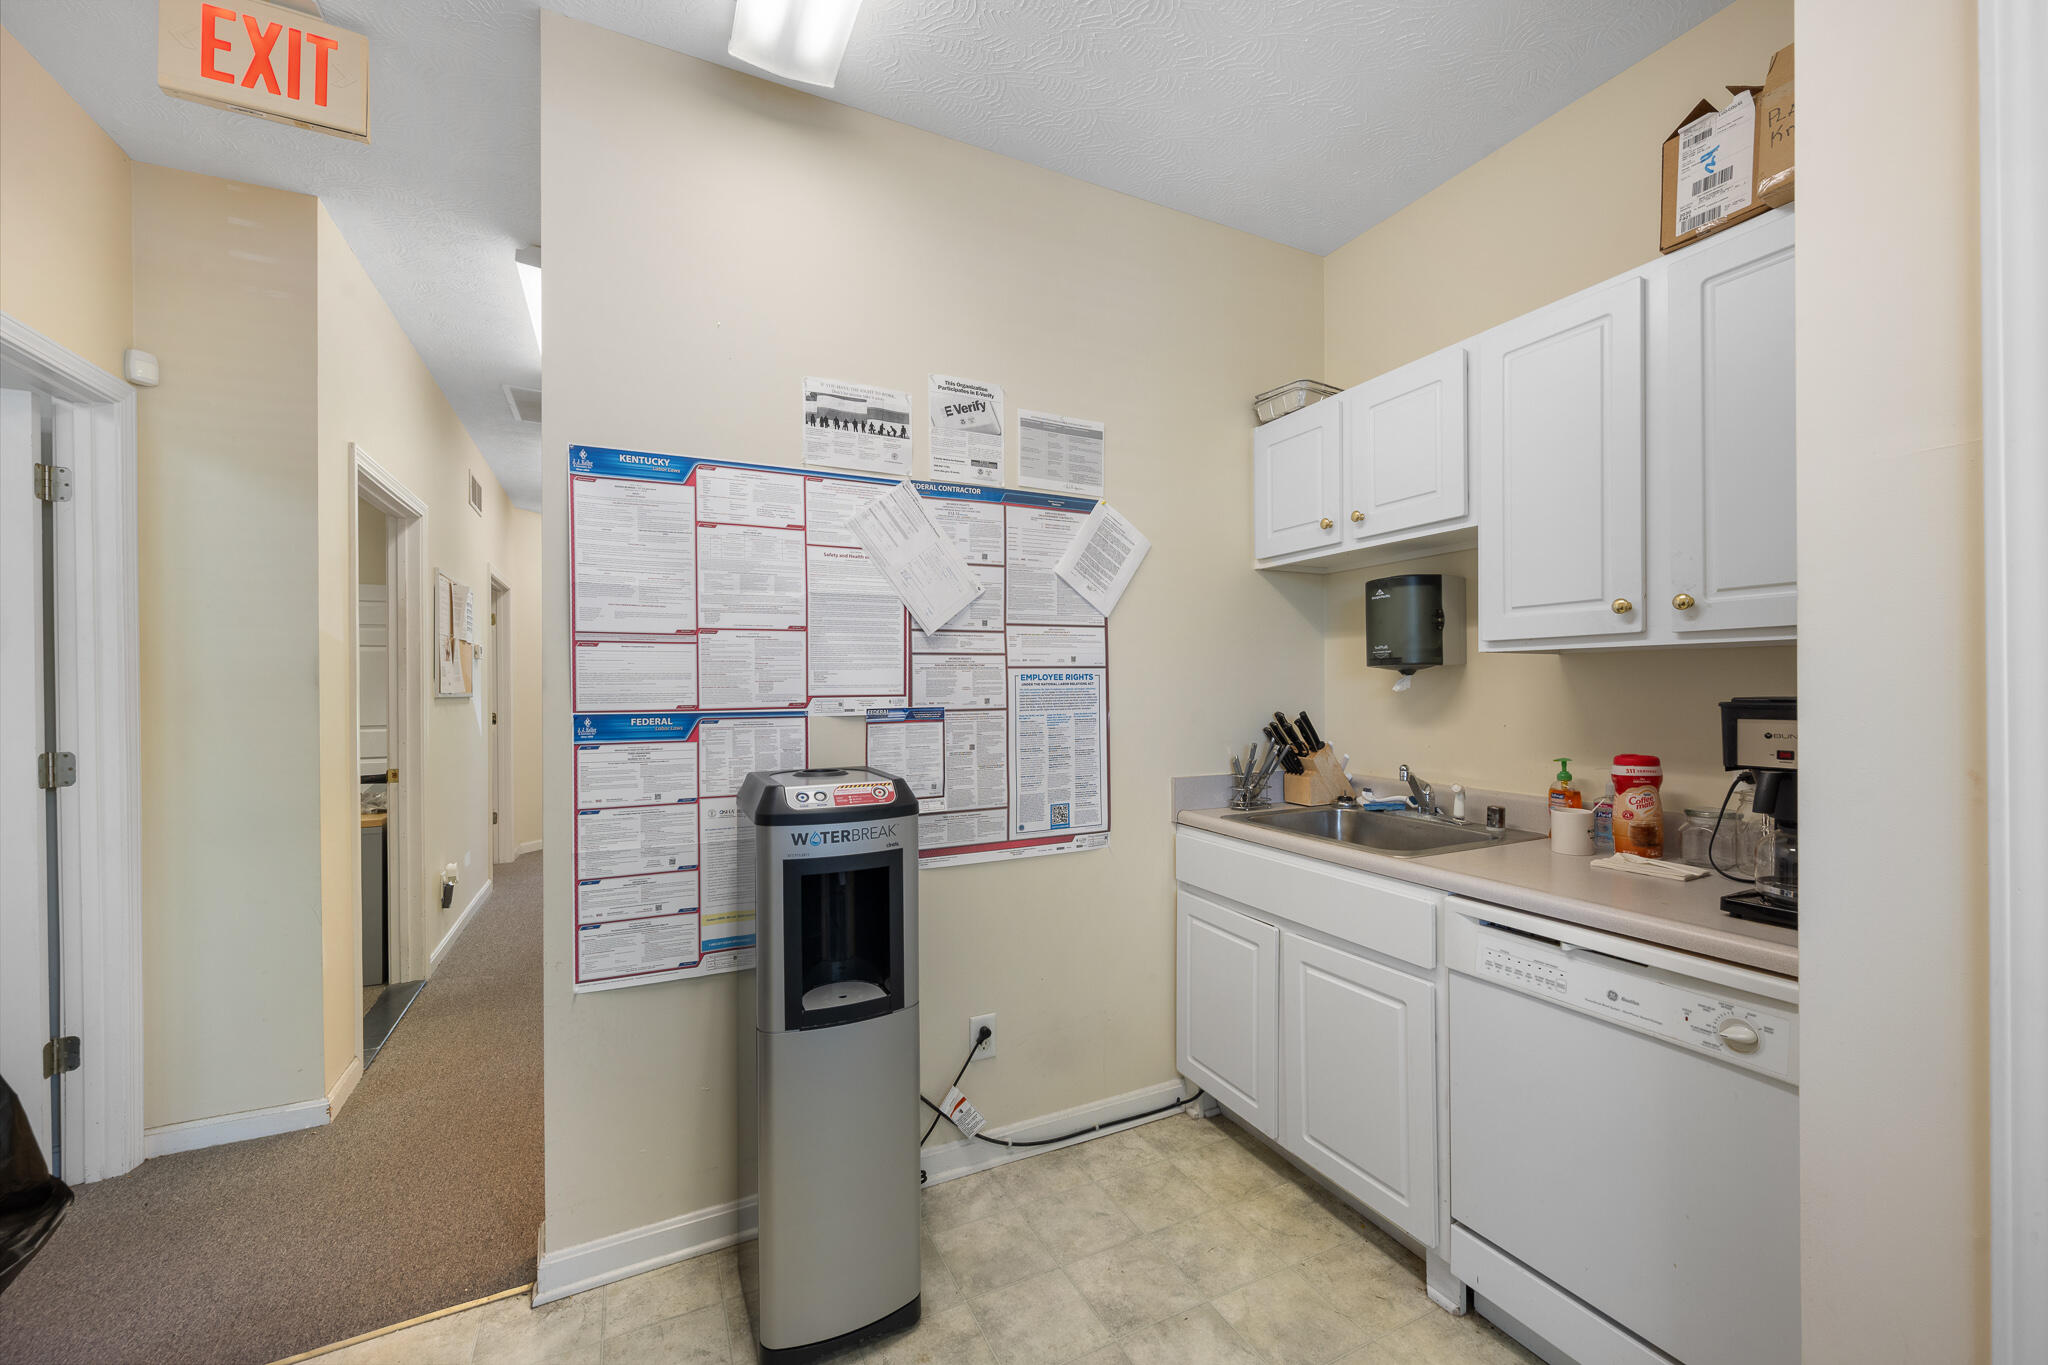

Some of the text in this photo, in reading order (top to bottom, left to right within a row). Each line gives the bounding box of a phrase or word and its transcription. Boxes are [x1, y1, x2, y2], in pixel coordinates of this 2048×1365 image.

[201, 3, 338, 107] EXIT
[938, 385, 970, 394] Participates
[956, 382, 988, 392] Organization
[619, 454, 670, 466] KENTUCKY
[912, 482, 981, 494] EDERAL CONTRACTOR
[630, 718, 672, 726] FEDERAL
[1628, 796, 1655, 806] Coffee
[1636, 802, 1655, 810] mate
